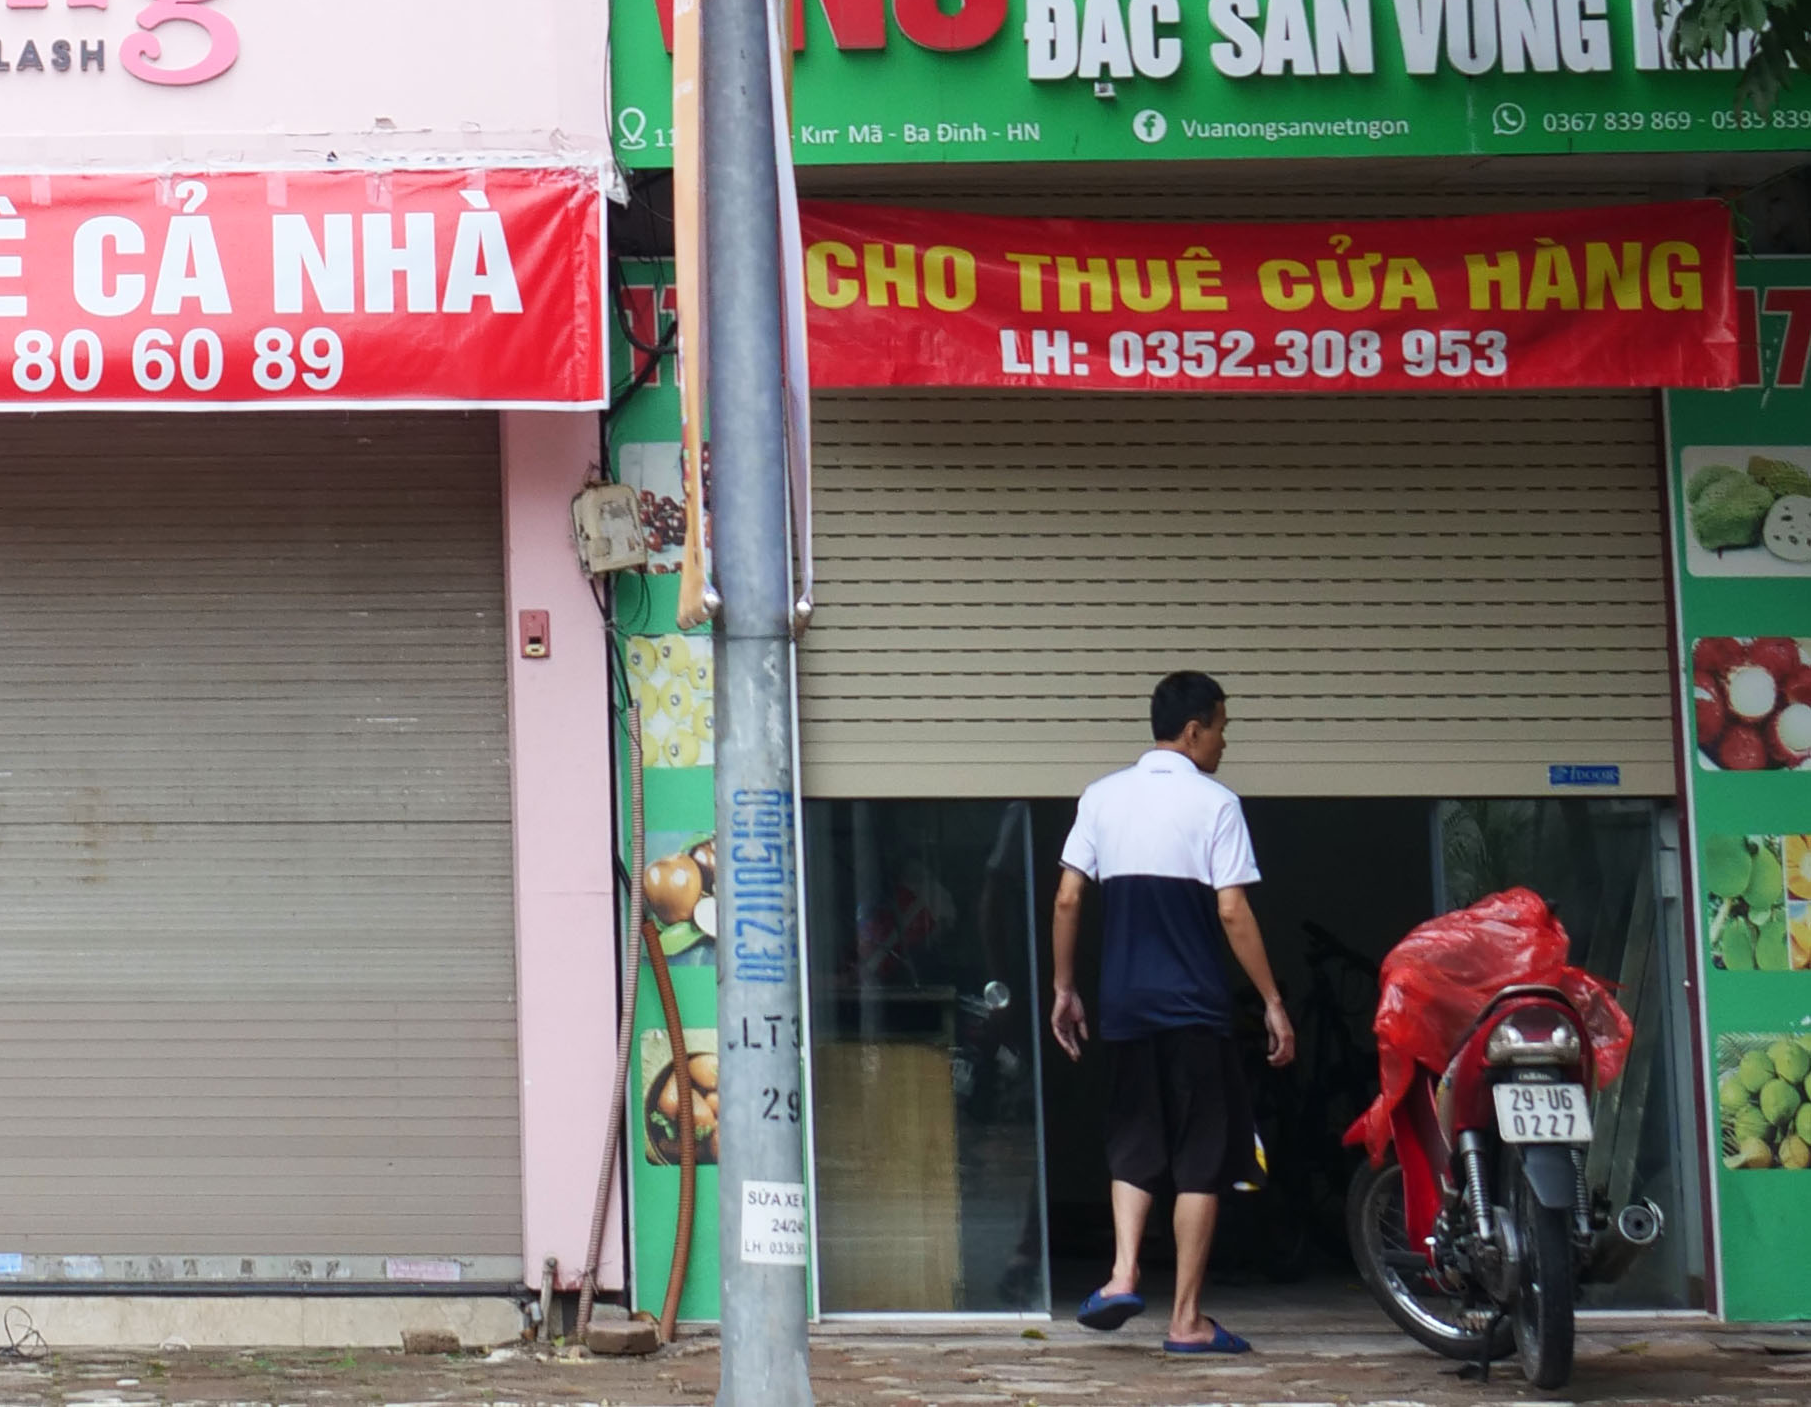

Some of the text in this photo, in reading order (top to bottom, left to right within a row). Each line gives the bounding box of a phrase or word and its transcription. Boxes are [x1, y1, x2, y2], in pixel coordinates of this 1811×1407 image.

[849, 122, 883, 143] Mã
[904, 124, 931, 143] Ba
[937, 121, 987, 143] Đình
[1006, 123, 1041, 142] HN
[1543, 112, 1596, 132] 0367
[1604, 111, 1644, 131] 839
[1650, 110, 1691, 130] 869
[73, 180, 232, 316] CẢ
[272, 190, 523, 314] NHÀ
[806, 234, 1704, 312] CHO THUÊ CỬA HÀNG
[12, 329, 103, 392] 80
[131, 328, 223, 391] 60
[252, 327, 344, 391] 89
[999, 329, 1508, 378] LH: 0352.308 953
[1509, 1087, 1574, 1111] 29-U6
[1513, 1113, 1576, 1137] 0227
